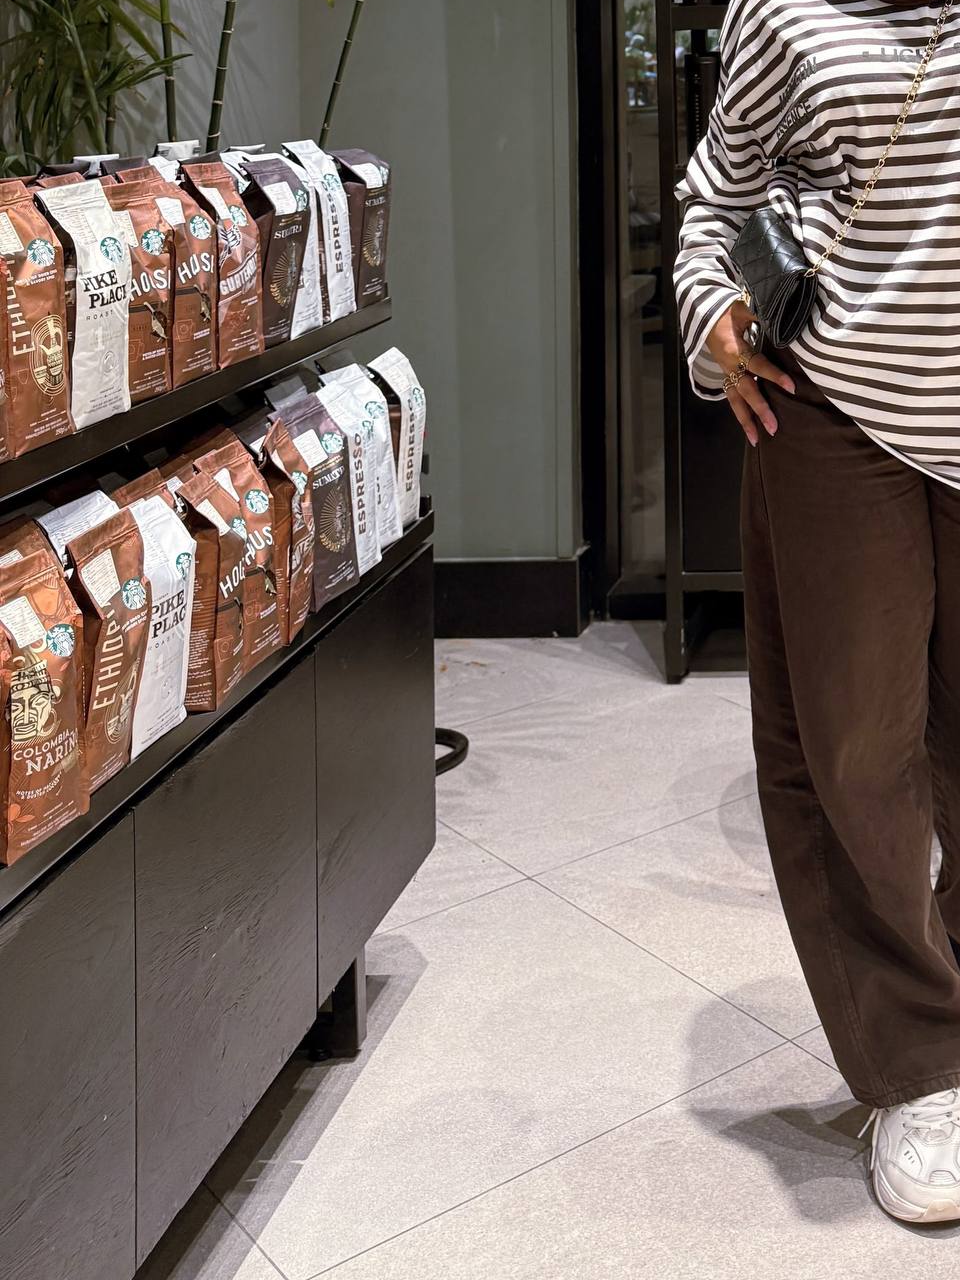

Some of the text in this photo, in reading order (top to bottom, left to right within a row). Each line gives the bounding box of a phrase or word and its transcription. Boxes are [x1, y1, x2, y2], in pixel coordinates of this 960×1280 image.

[86, 309, 114, 320] ROAST
[353, 433, 367, 535] ESPRESSO
[13, 728, 72, 760] COLOMBIA
